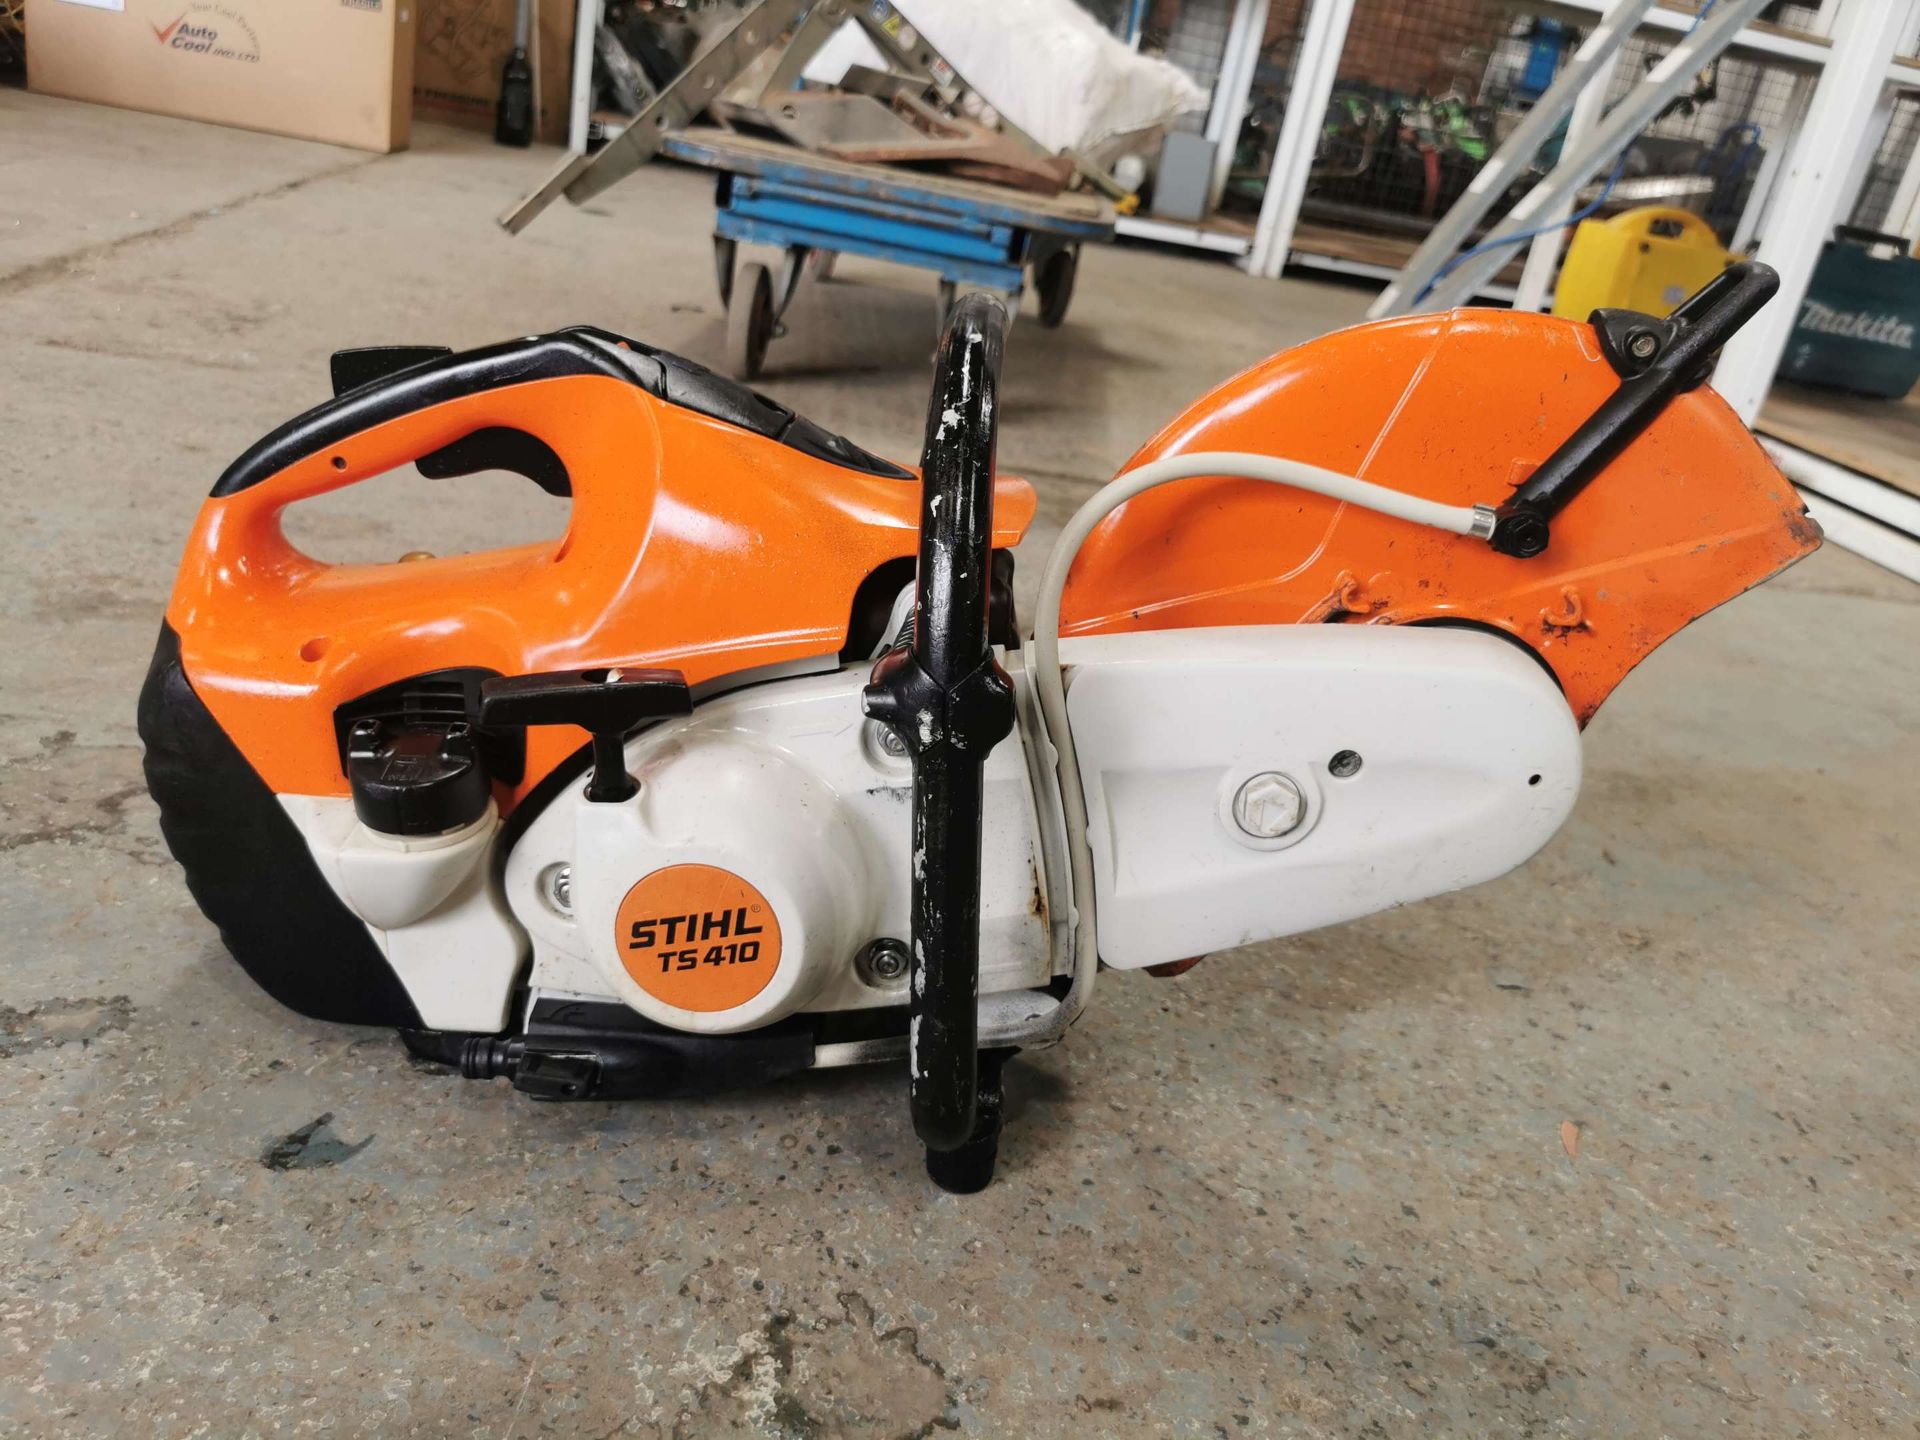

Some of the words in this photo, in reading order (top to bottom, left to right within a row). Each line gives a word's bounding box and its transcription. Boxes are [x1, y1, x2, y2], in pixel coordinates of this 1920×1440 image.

[177, 23, 217, 41] Auto
[171, 37, 213, 54] Cool
[629, 907, 763, 949] STIHL
[657, 948, 698, 973] TS
[703, 941, 760, 967] 410
